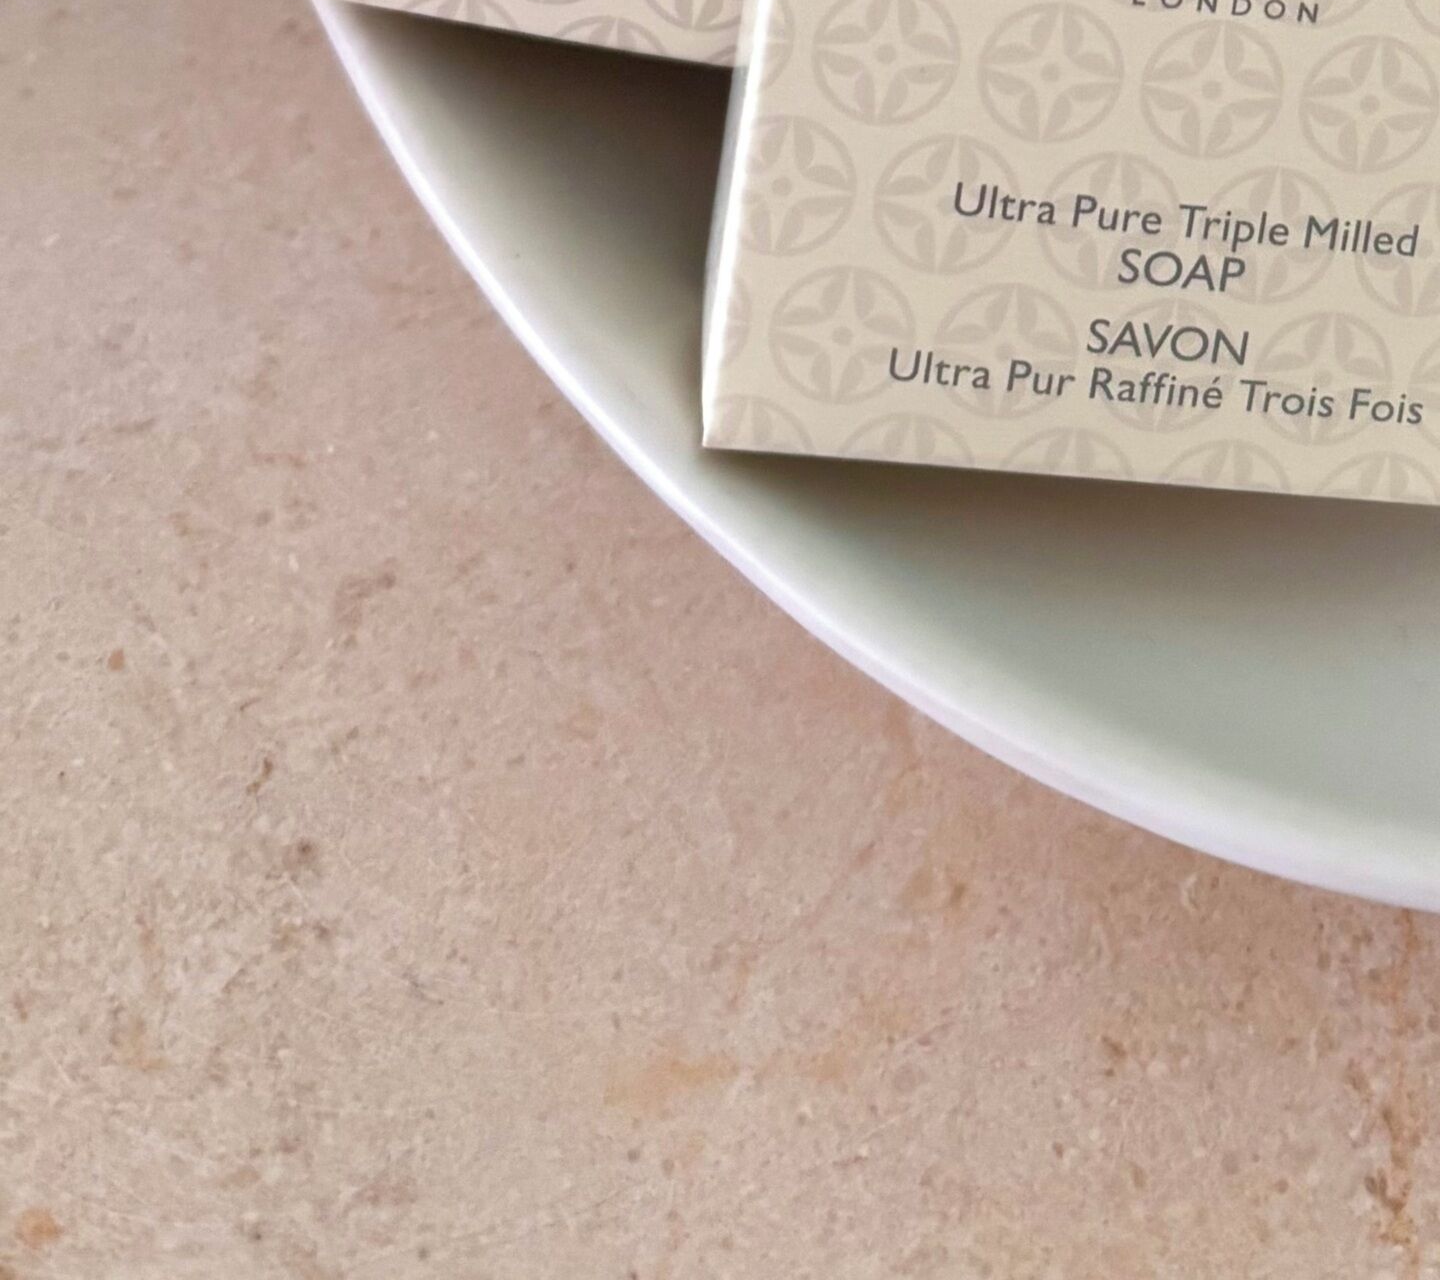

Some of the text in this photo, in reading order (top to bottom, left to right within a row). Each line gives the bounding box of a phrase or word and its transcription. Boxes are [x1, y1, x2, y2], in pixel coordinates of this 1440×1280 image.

[953, 182, 1420, 257] Ultra Pure Triple Milled
[1117, 248, 1246, 292] SOAP
[1087, 318, 1250, 366] SAVON
[888, 347, 1425, 425] Ultra Pur Raffiné Trois Fois
